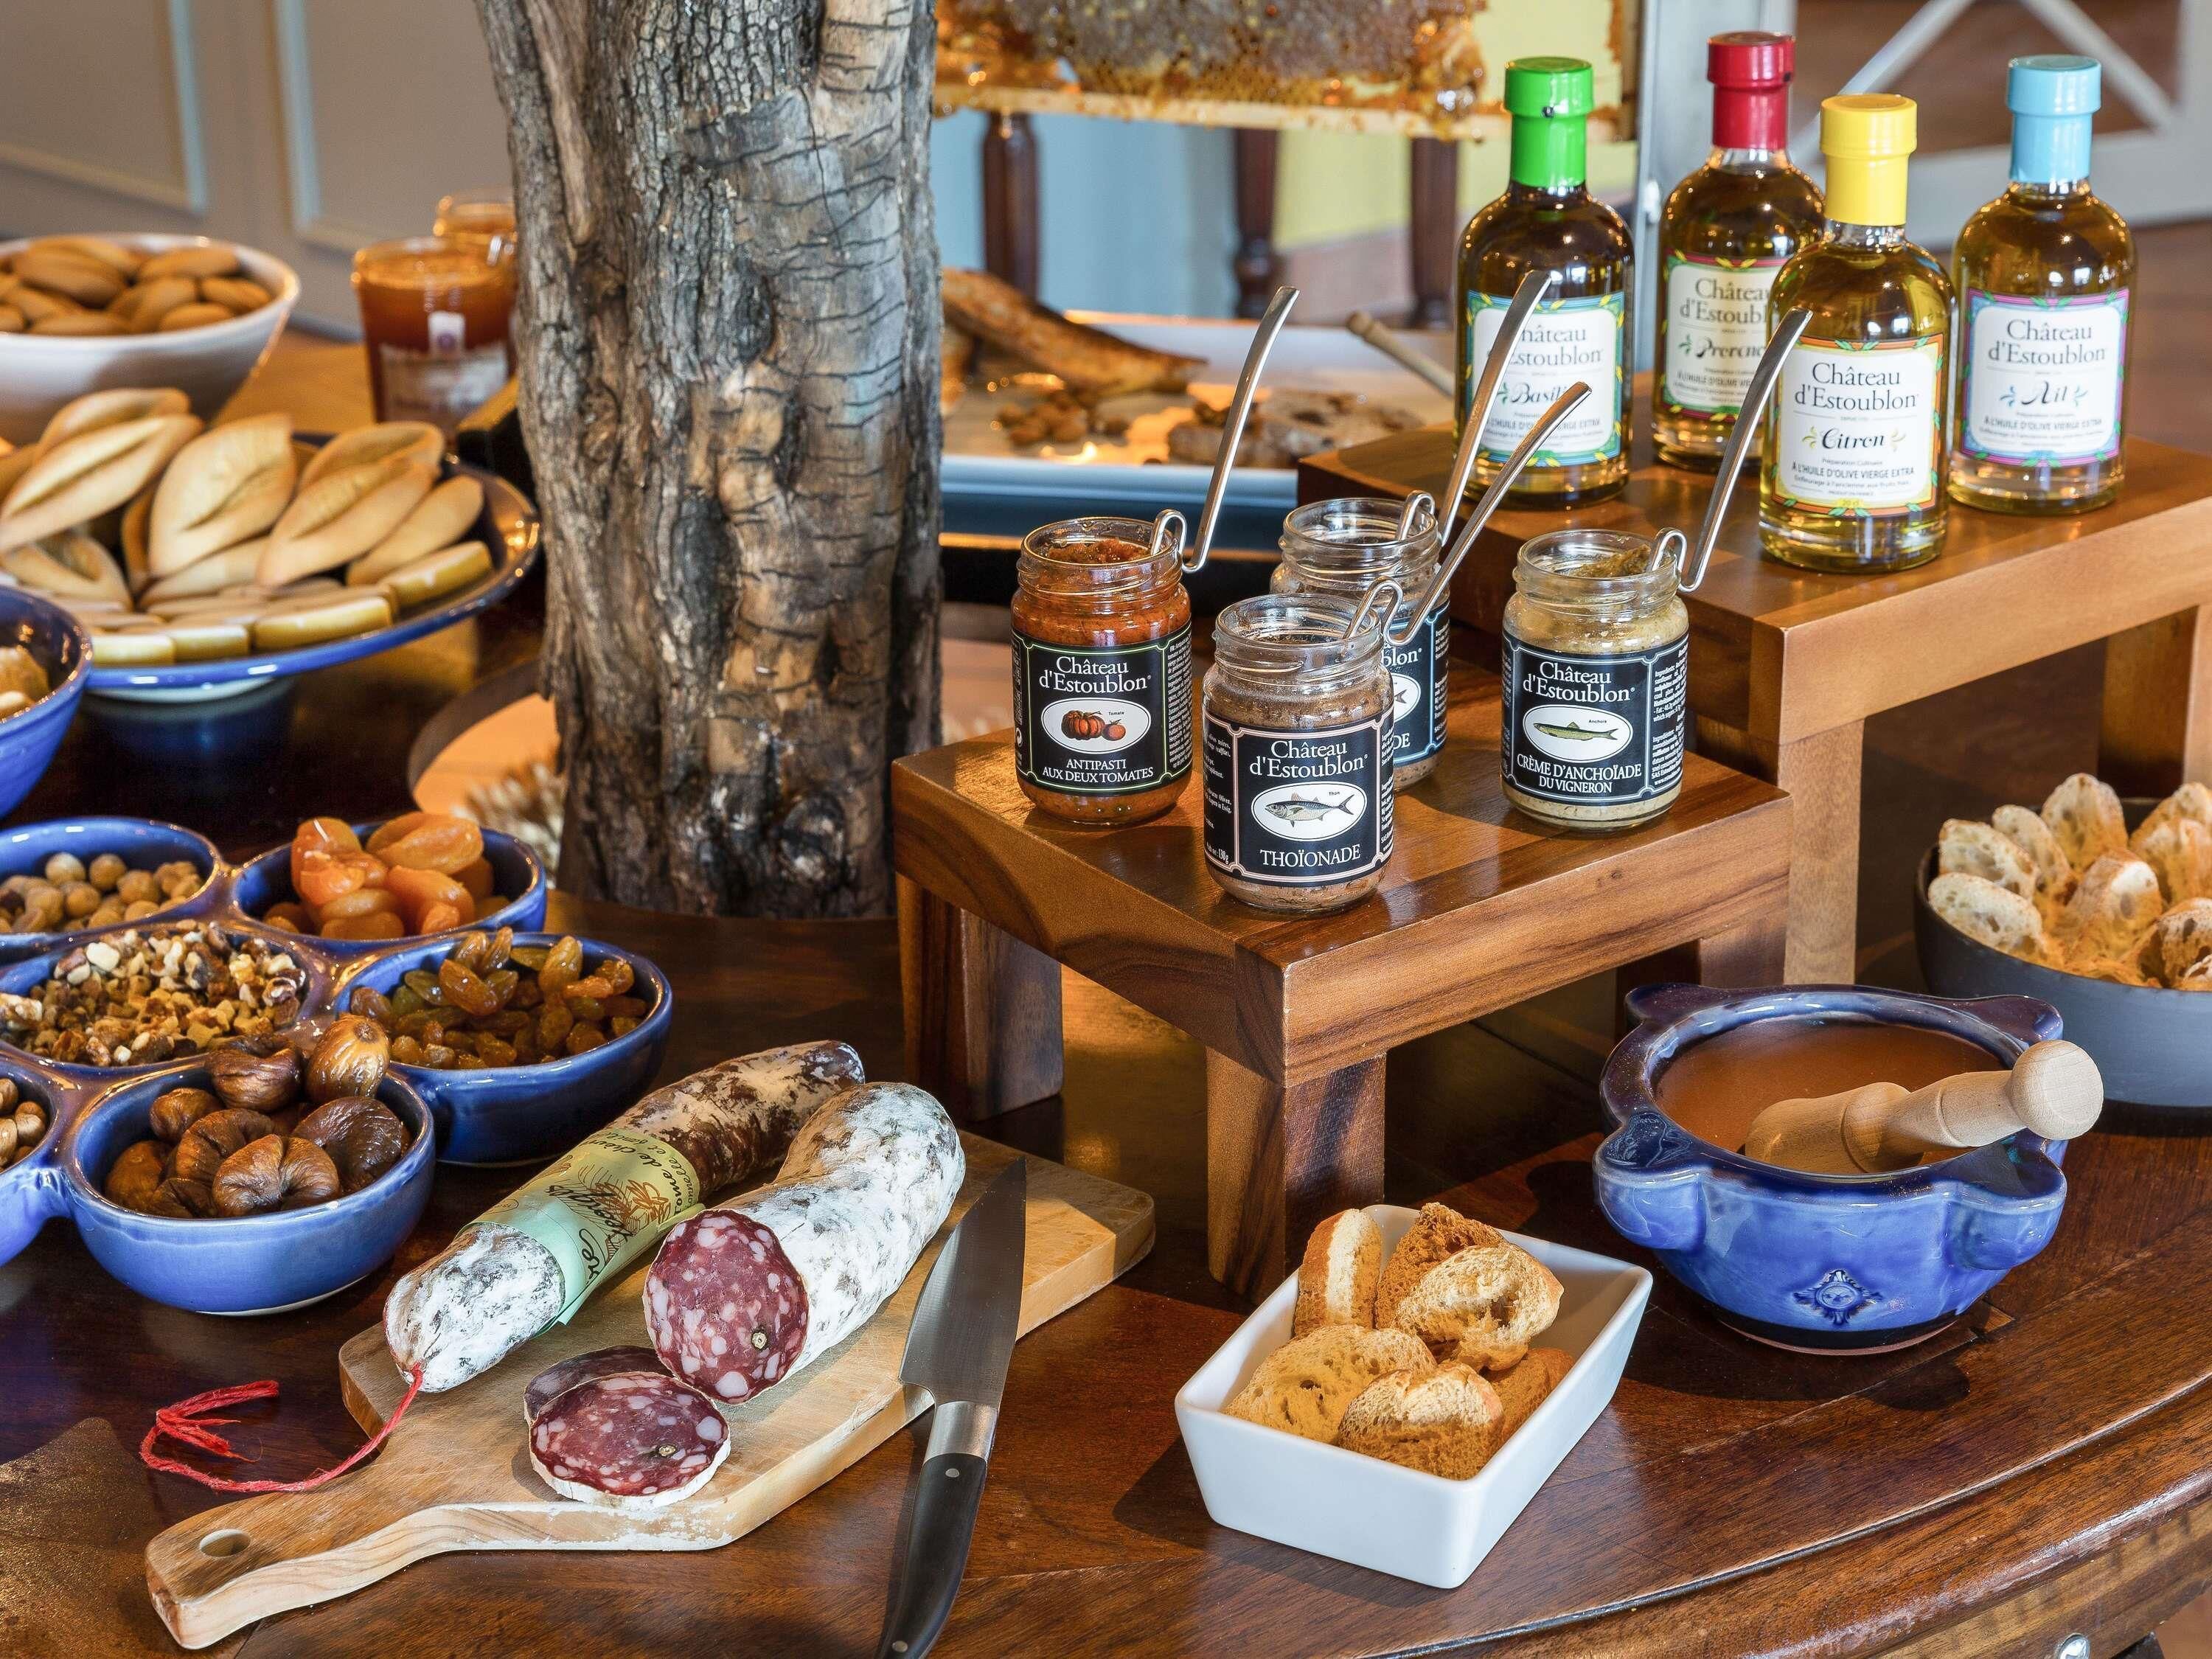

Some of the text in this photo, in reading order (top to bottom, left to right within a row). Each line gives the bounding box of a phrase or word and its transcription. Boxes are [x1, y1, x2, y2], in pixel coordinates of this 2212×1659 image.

[1680, 299, 1767, 324] d'Estoubl
[1521, 324, 1587, 343] hâteau
[2007, 319, 2092, 341] Château
[1696, 335, 1766, 359] Provenc
[1988, 341, 2105, 364] d'Estoublon
[1812, 362, 1900, 386] Château
[1794, 384, 1917, 411] d'Estoublon
[1822, 428, 1885, 449] Citron
[1826, 468, 1858, 479] D'OLIVE
[1861, 469, 1888, 479] VIERGE
[1891, 467, 1914, 478] EXTRA
[1056, 656, 1129, 675] Château
[1540, 661, 1611, 684] Château
[1271, 741, 1347, 759] Château
[1043, 767, 1154, 782] AUX DEUX TOMATES
[1066, 759, 1127, 769] ANTIPASTI
[1517, 754, 1551, 775] CRÈME
[1554, 764, 1642, 780] D'ANCHOÏADE
[1540, 776, 1613, 793] DU VIGNERON
[1260, 844, 1360, 867] THOÏONADE
